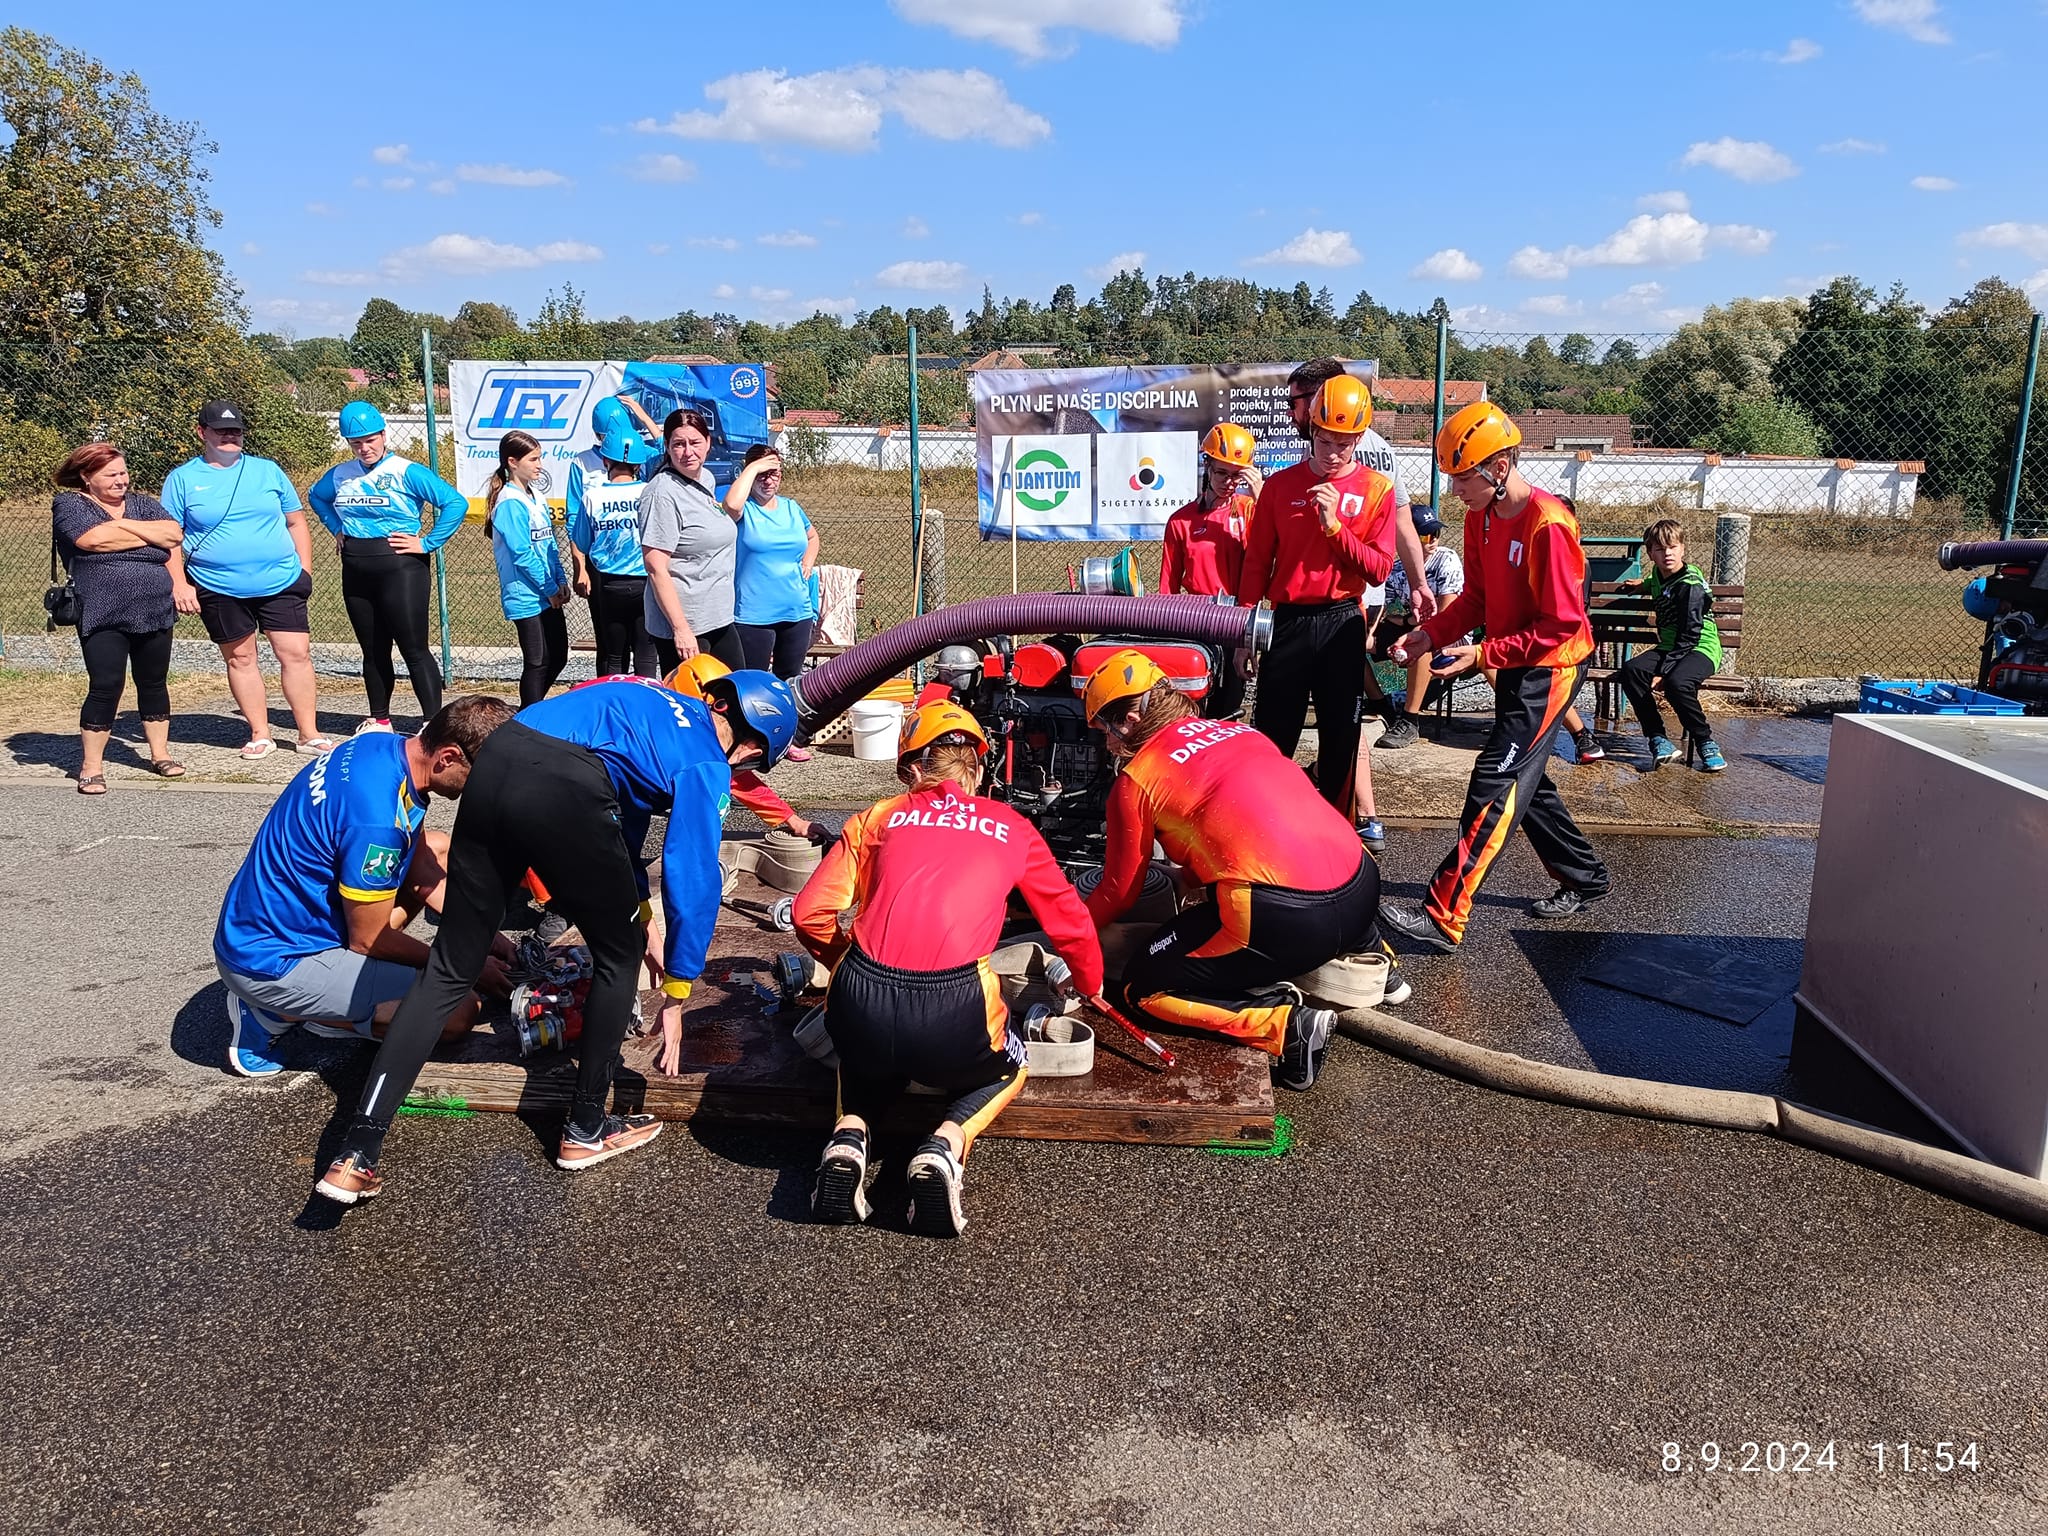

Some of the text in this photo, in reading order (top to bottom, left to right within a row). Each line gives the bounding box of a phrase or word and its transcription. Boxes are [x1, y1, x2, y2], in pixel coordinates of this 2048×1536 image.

[730, 377, 760, 391] 1998
[1230, 385, 1291, 399] prodej a dod
[991, 385, 1199, 413] PLYN JE NAŠE DISCIPLÍNA
[1230, 399, 1291, 412] projekty, ins
[1230, 411, 1293, 425] domovní příp
[1248, 425, 1299, 438] lny, konde
[464, 445, 500, 458] Trans
[1255, 438, 1287, 450] níkové
[1254, 451, 1303, 462] ění rodinn
[1355, 447, 1394, 472] HASIČI
[1001, 470, 1081, 490] QUANTUM
[602, 497, 641, 513] HASIČ
[1177, 720, 1221, 738] SDH
[1169, 725, 1256, 764] DALEŠIC
[930, 793, 976, 813] SDH
[887, 809, 1010, 844] DALEŠICE
[1149, 930, 1177, 955] ddsport
